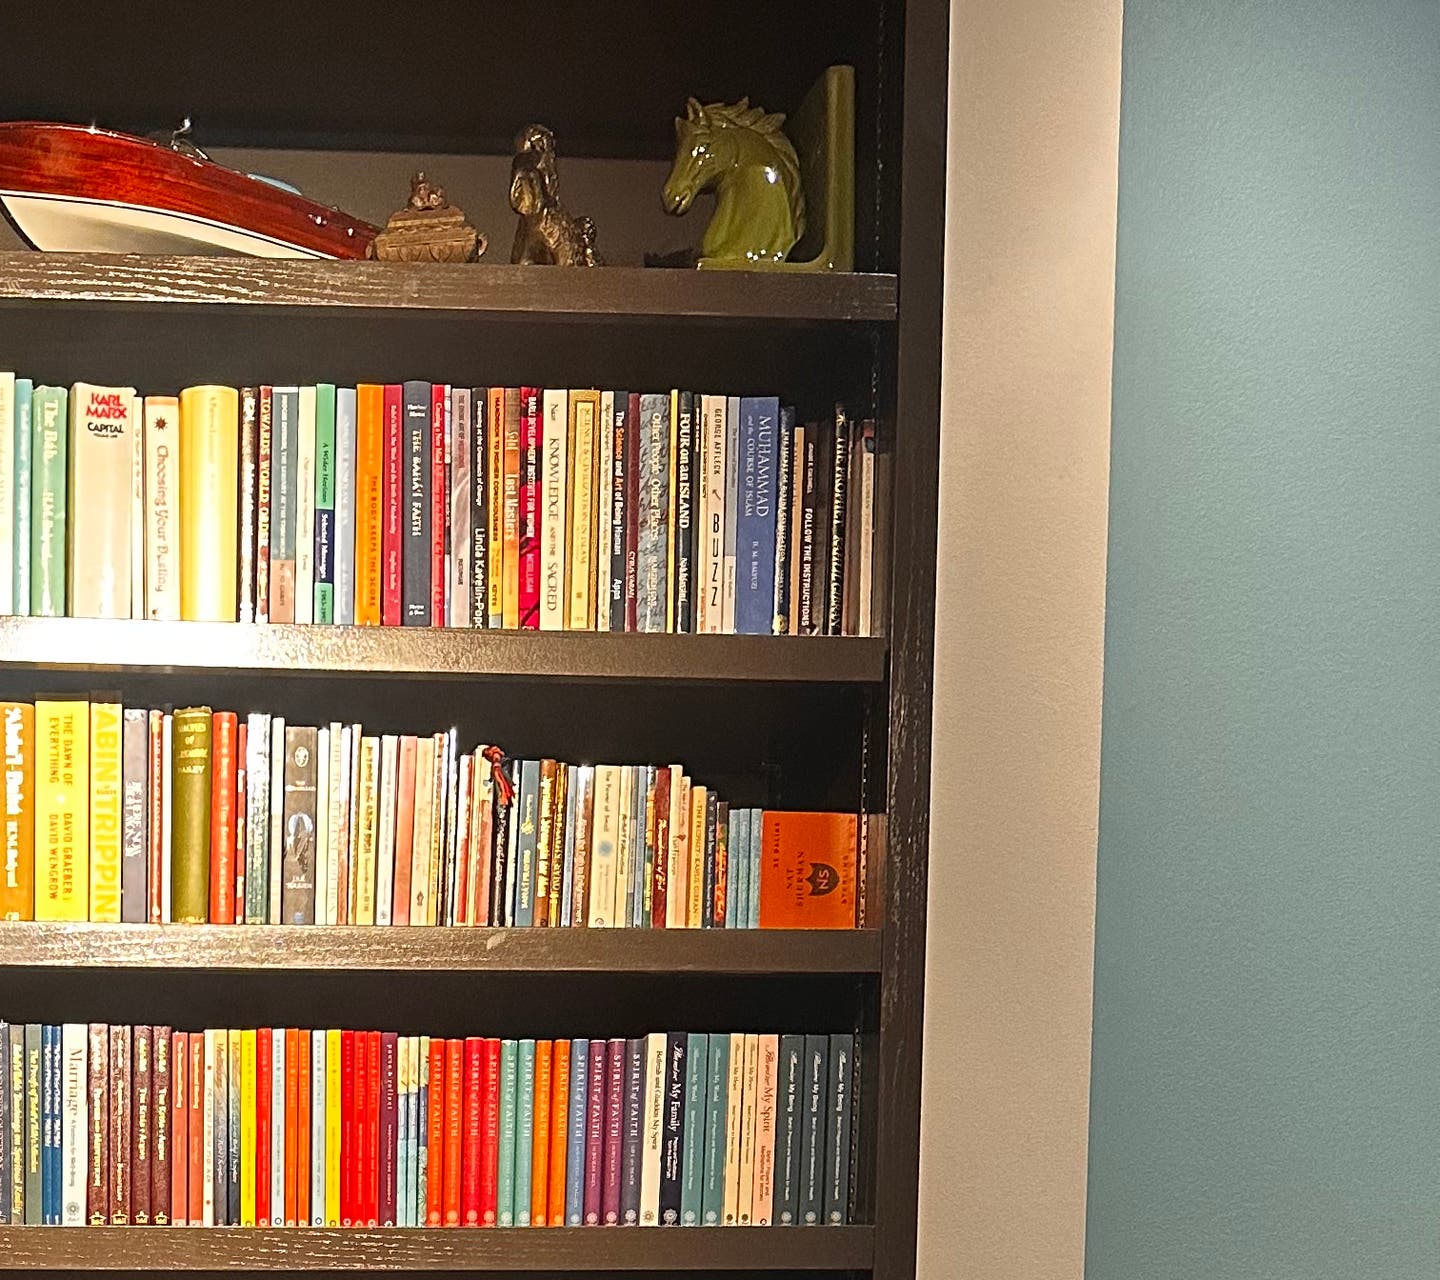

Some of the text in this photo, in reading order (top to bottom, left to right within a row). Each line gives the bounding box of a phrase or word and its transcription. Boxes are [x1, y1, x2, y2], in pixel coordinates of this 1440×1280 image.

[87, 406, 127, 419] MARX
[92, 393, 123, 407] KARL
[88, 422, 124, 433] CAPITAL
[680, 413, 691, 446] FOUR
[757, 416, 771, 516] MUHAMMAD
[679, 482, 690, 528] ISLAND
[64, 741, 72, 768] DAWN
[64, 772, 72, 786] OF
[630, 1104, 639, 1136] FAITH
